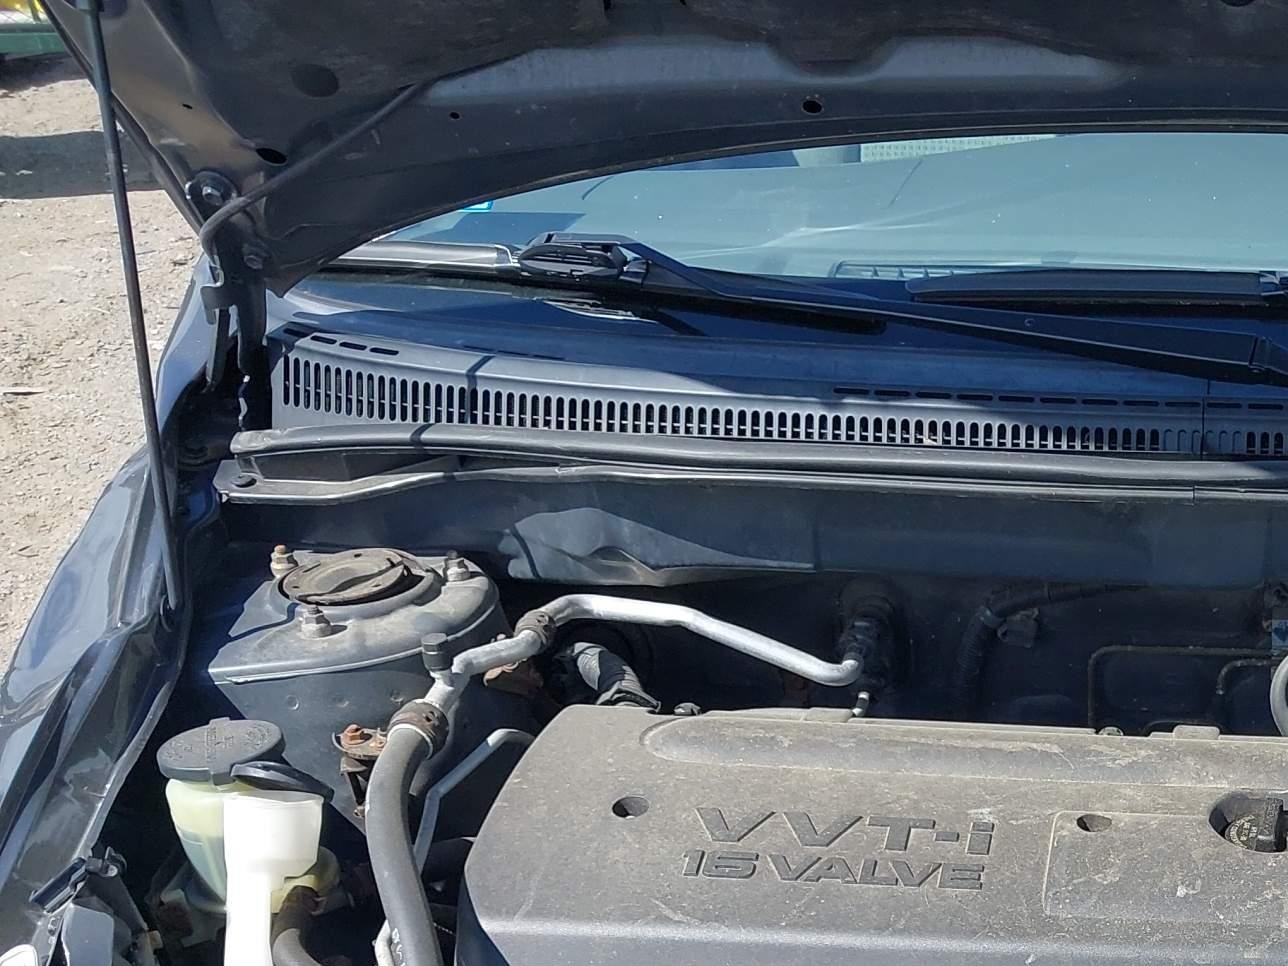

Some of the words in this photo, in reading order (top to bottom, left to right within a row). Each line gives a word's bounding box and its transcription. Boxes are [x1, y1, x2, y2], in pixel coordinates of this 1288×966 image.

[695, 806, 996, 856] VVT-i
[681, 849, 760, 880] 16
[766, 852, 985, 891] VALVE
